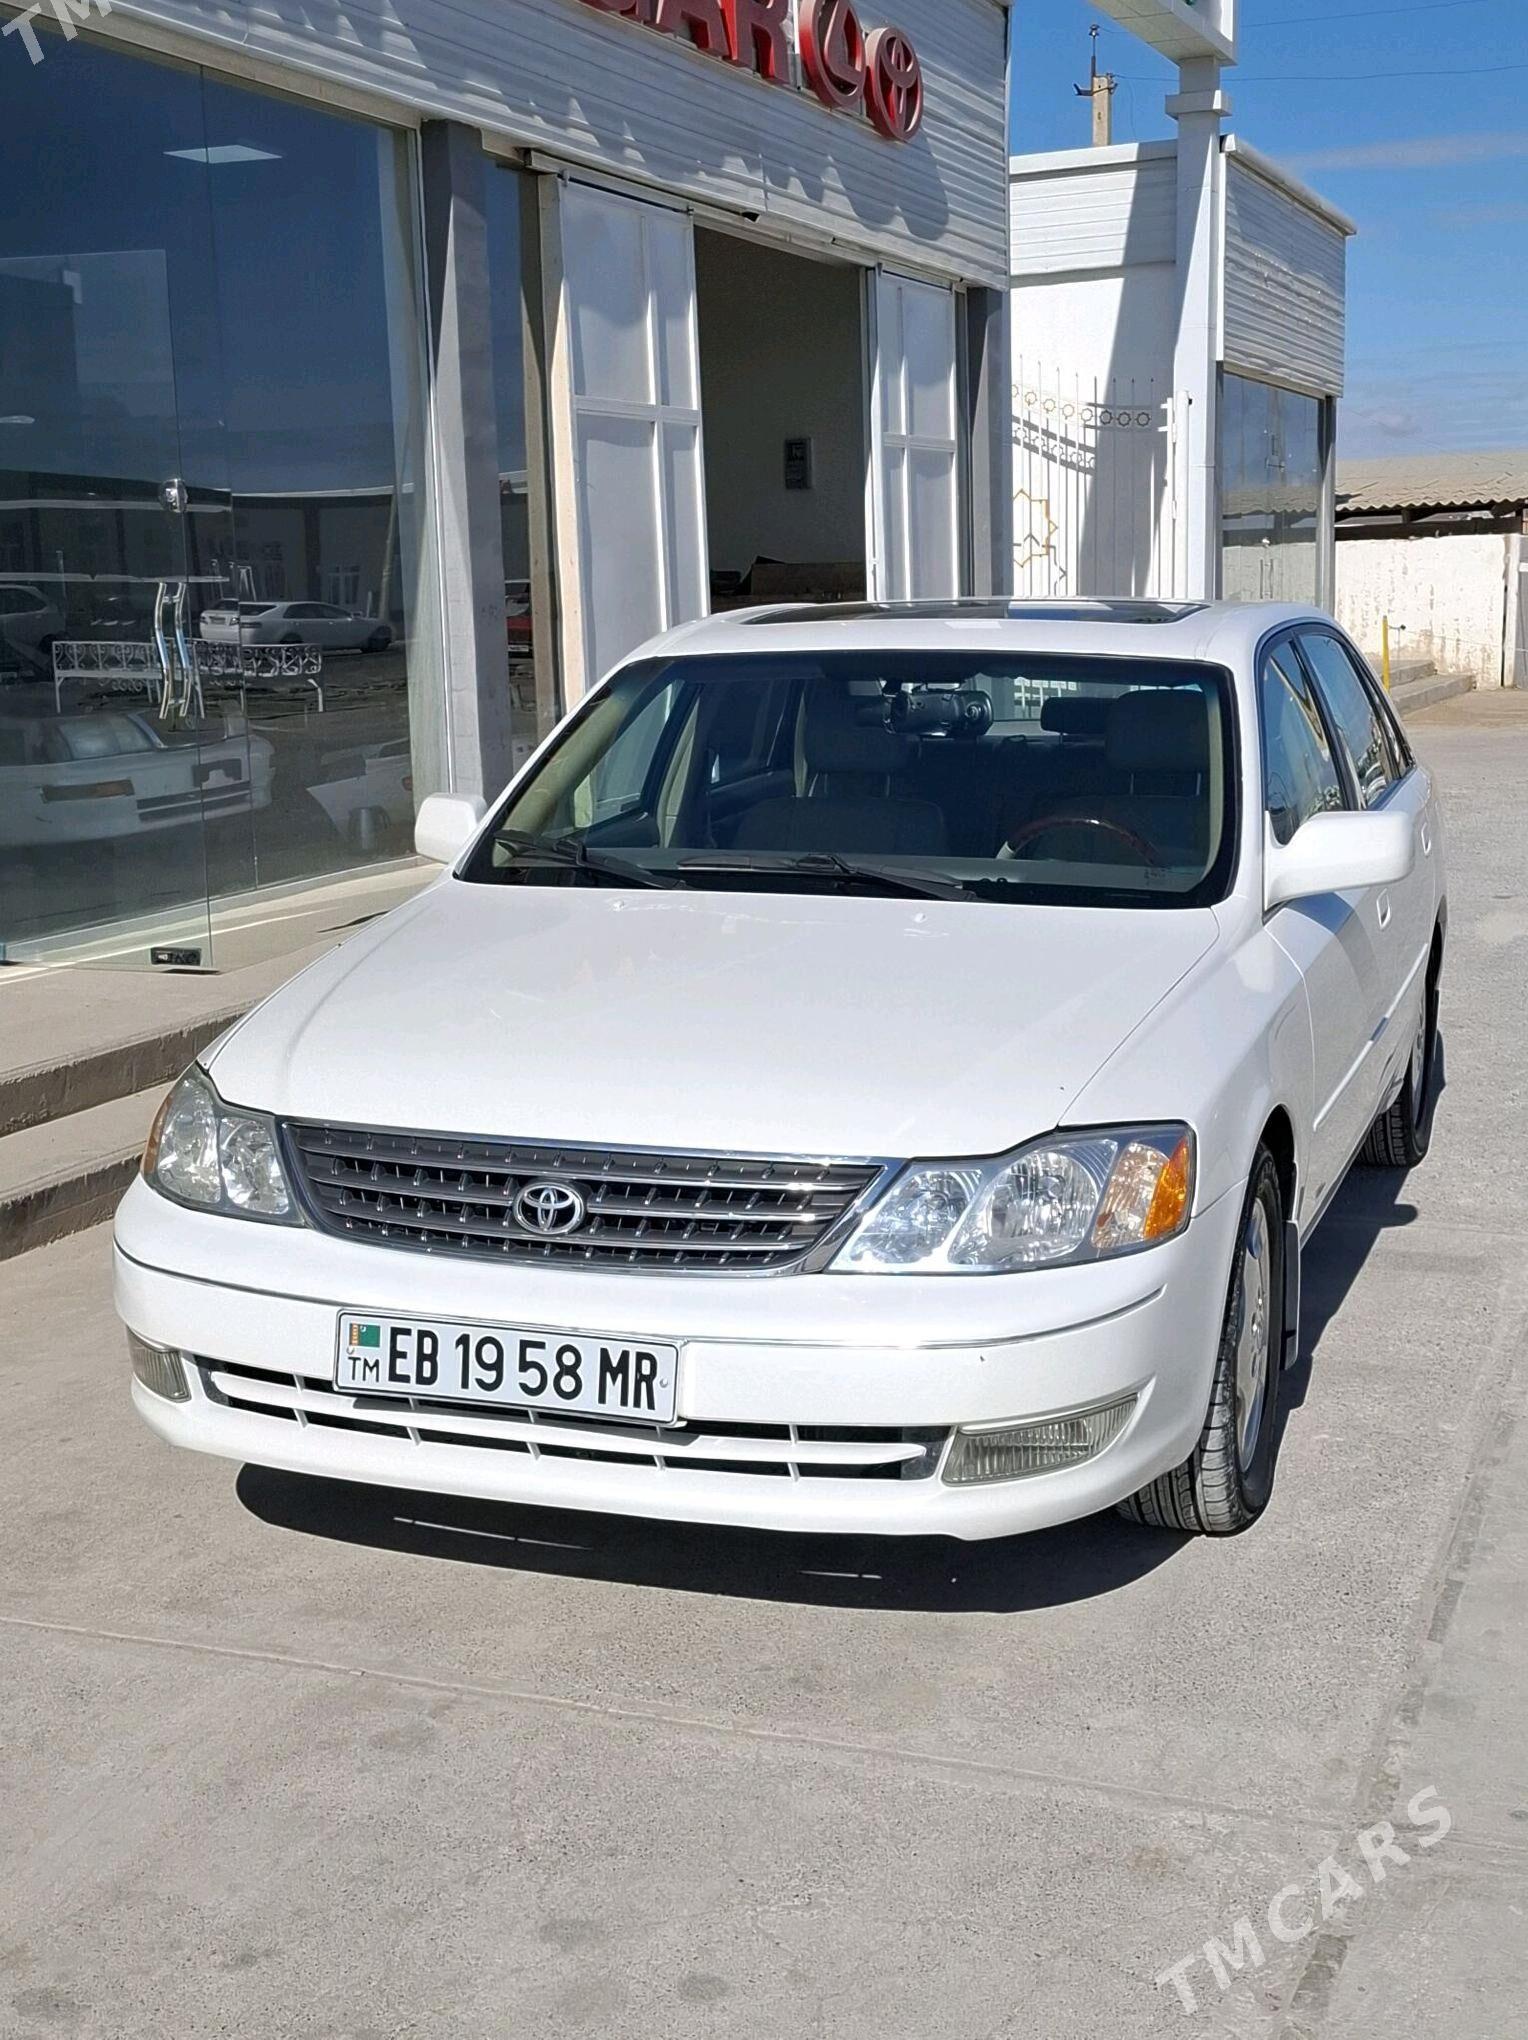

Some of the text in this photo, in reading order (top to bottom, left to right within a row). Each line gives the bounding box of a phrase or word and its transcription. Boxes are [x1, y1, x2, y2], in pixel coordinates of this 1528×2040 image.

[347, 1356, 380, 1383] TM
[388, 1326, 439, 1386] EB
[597, 1347, 658, 1411] MR
